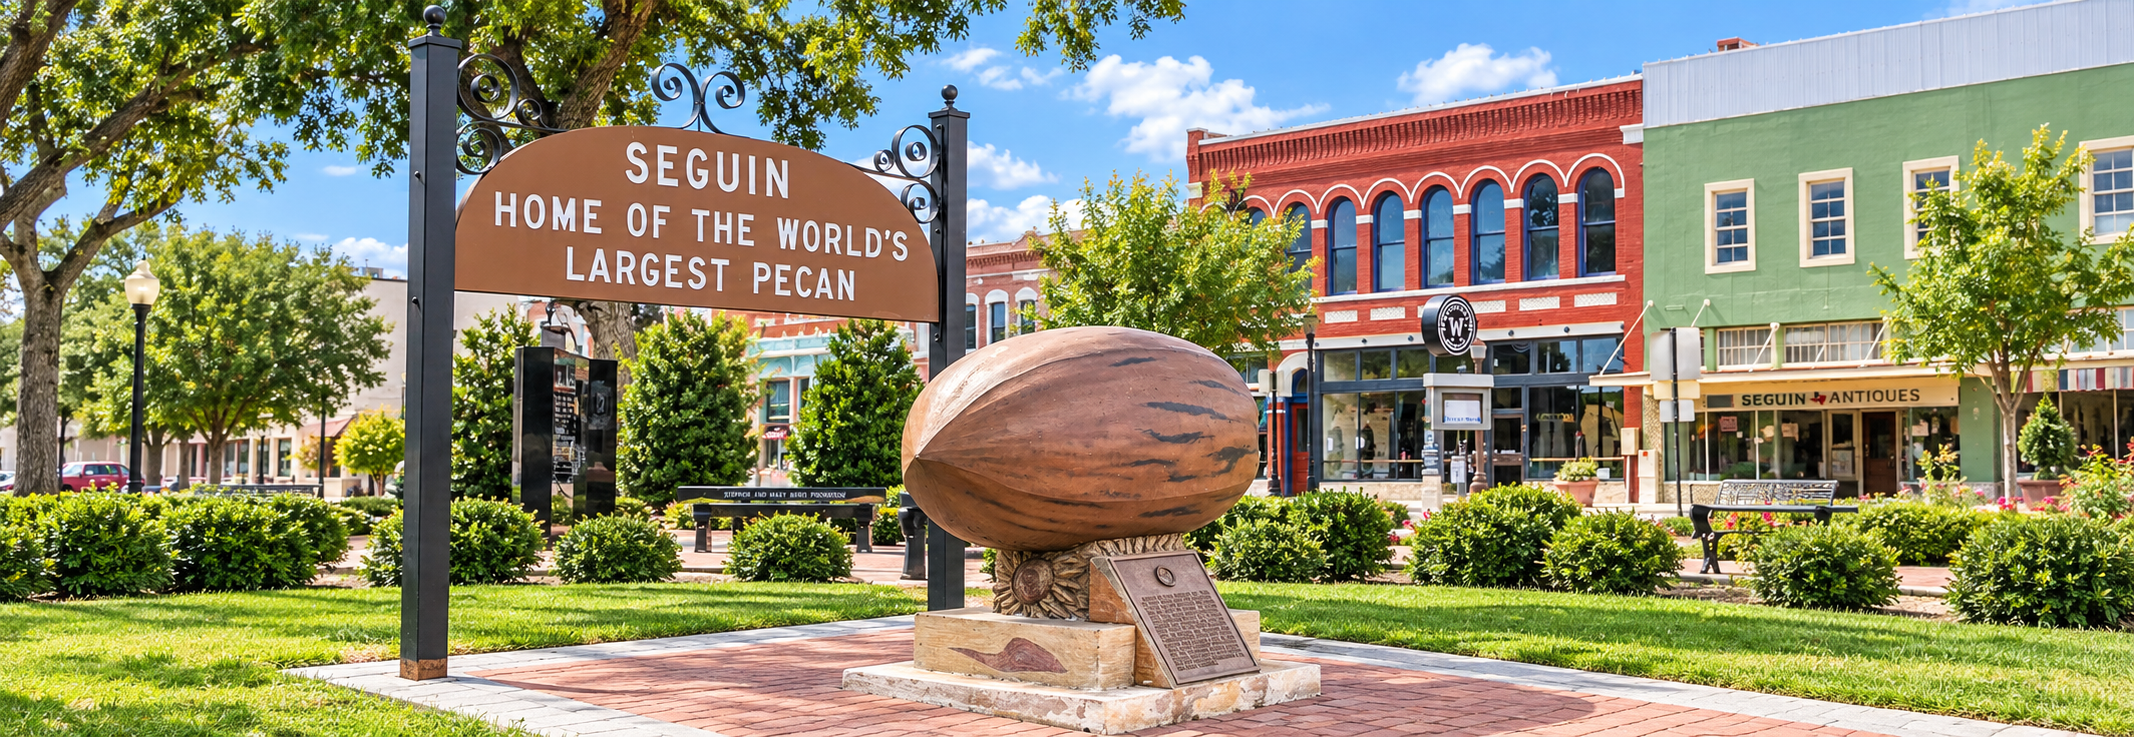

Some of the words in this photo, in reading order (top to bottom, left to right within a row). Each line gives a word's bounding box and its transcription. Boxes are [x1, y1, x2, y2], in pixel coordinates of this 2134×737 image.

[625, 141, 790, 199] SEGUIN
[494, 191, 602, 235] HOME
[626, 202, 671, 239] OF
[691, 208, 756, 247] THE
[776, 217, 909, 262] WORLD'S
[565, 245, 730, 292] LARGEST
[752, 261, 856, 301] PECAN
[1448, 316, 1465, 337] W
[1741, 393, 1806, 406] SEGUIN
[1828, 388, 1921, 405] ANTIQUES
